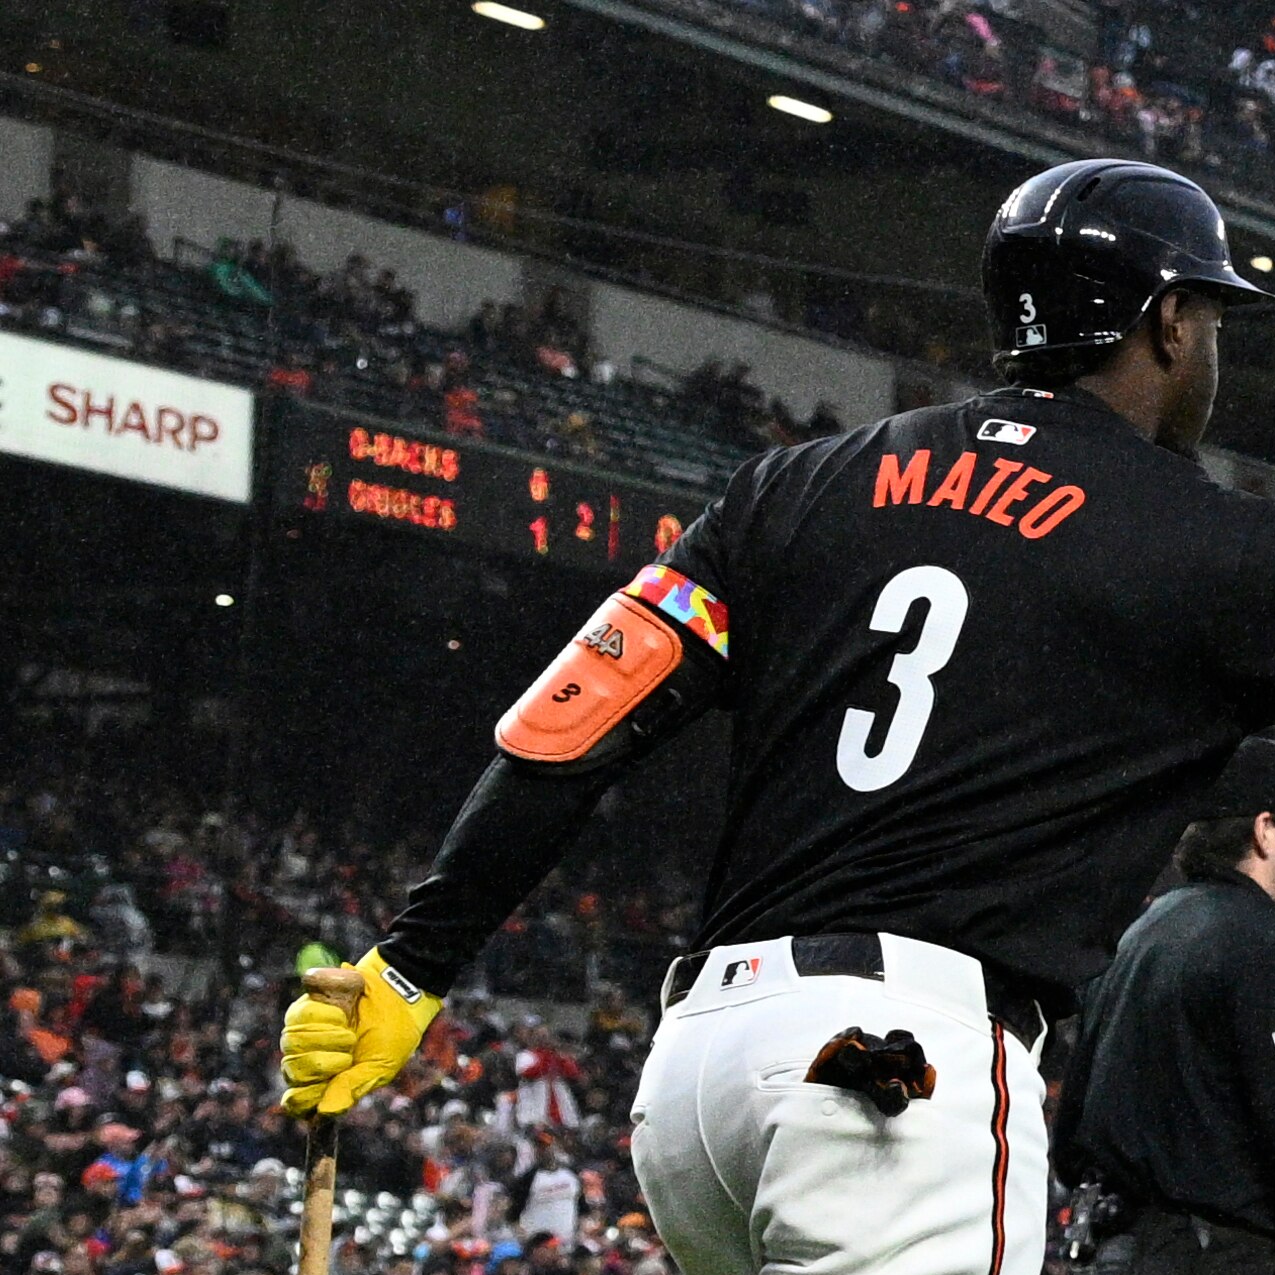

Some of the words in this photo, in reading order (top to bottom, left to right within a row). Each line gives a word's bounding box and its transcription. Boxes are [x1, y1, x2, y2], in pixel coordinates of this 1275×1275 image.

[1019, 292, 1037, 324] 3
[46, 382, 220, 452] SHARP
[872, 448, 1087, 540] MATEO
[552, 682, 582, 703] 3
[836, 565, 970, 793] 3
